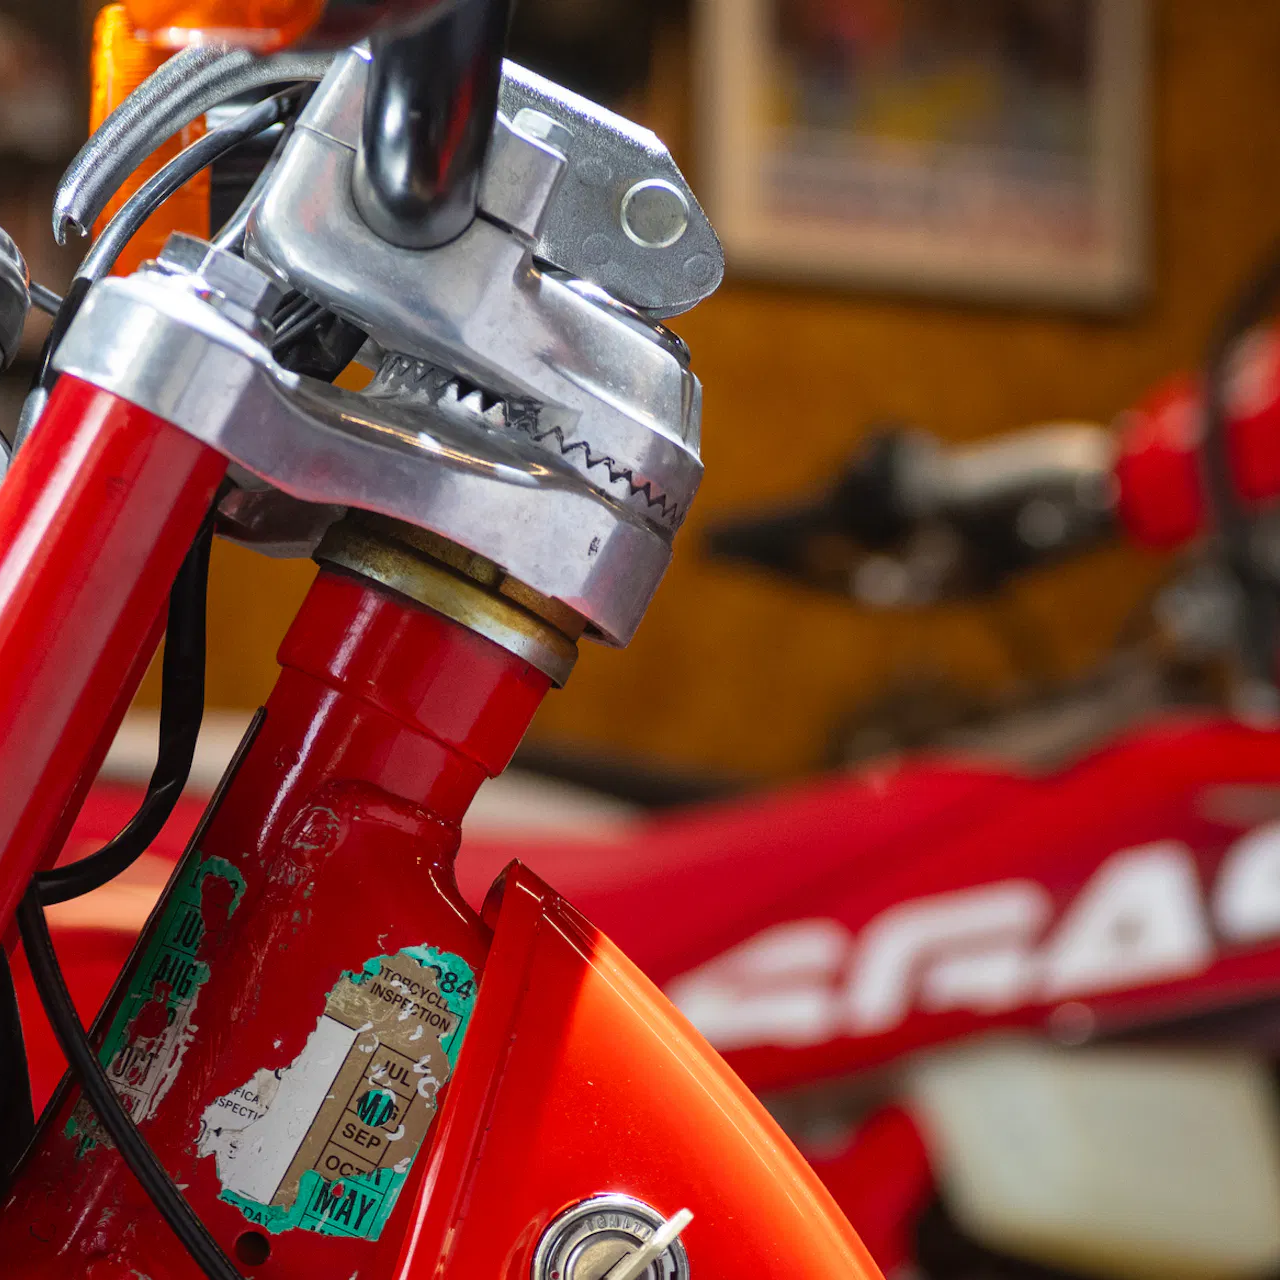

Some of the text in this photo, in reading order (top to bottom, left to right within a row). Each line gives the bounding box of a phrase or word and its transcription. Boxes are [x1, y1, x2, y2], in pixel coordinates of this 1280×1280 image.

[370, 982, 451, 1033] INSPECTION
[381, 1060, 410, 1087] JUL
[342, 1123, 381, 1150] SEP
[242, 1205, 275, 1228] DAY
[313, 1183, 376, 1231] MAY
